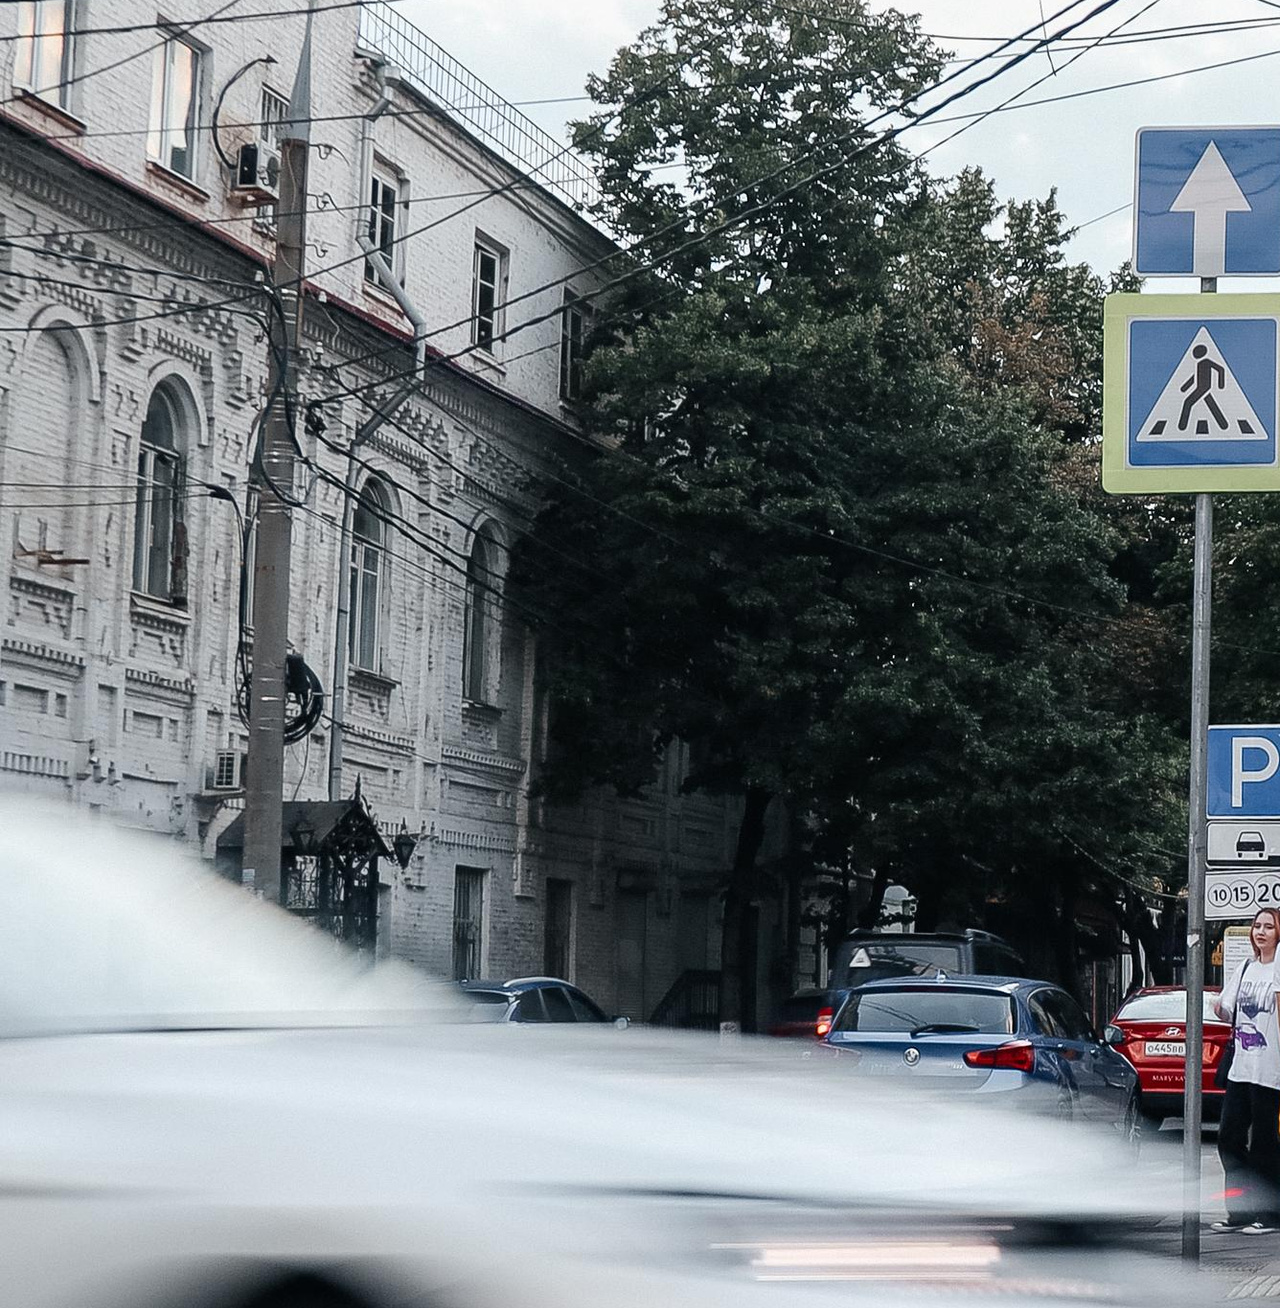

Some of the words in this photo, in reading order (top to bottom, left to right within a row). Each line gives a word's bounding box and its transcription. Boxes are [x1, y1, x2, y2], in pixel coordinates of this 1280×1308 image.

[1232, 737, 1280, 807] P
[1213, 889, 1227, 902] 10
[1232, 886, 1250, 902] 15
